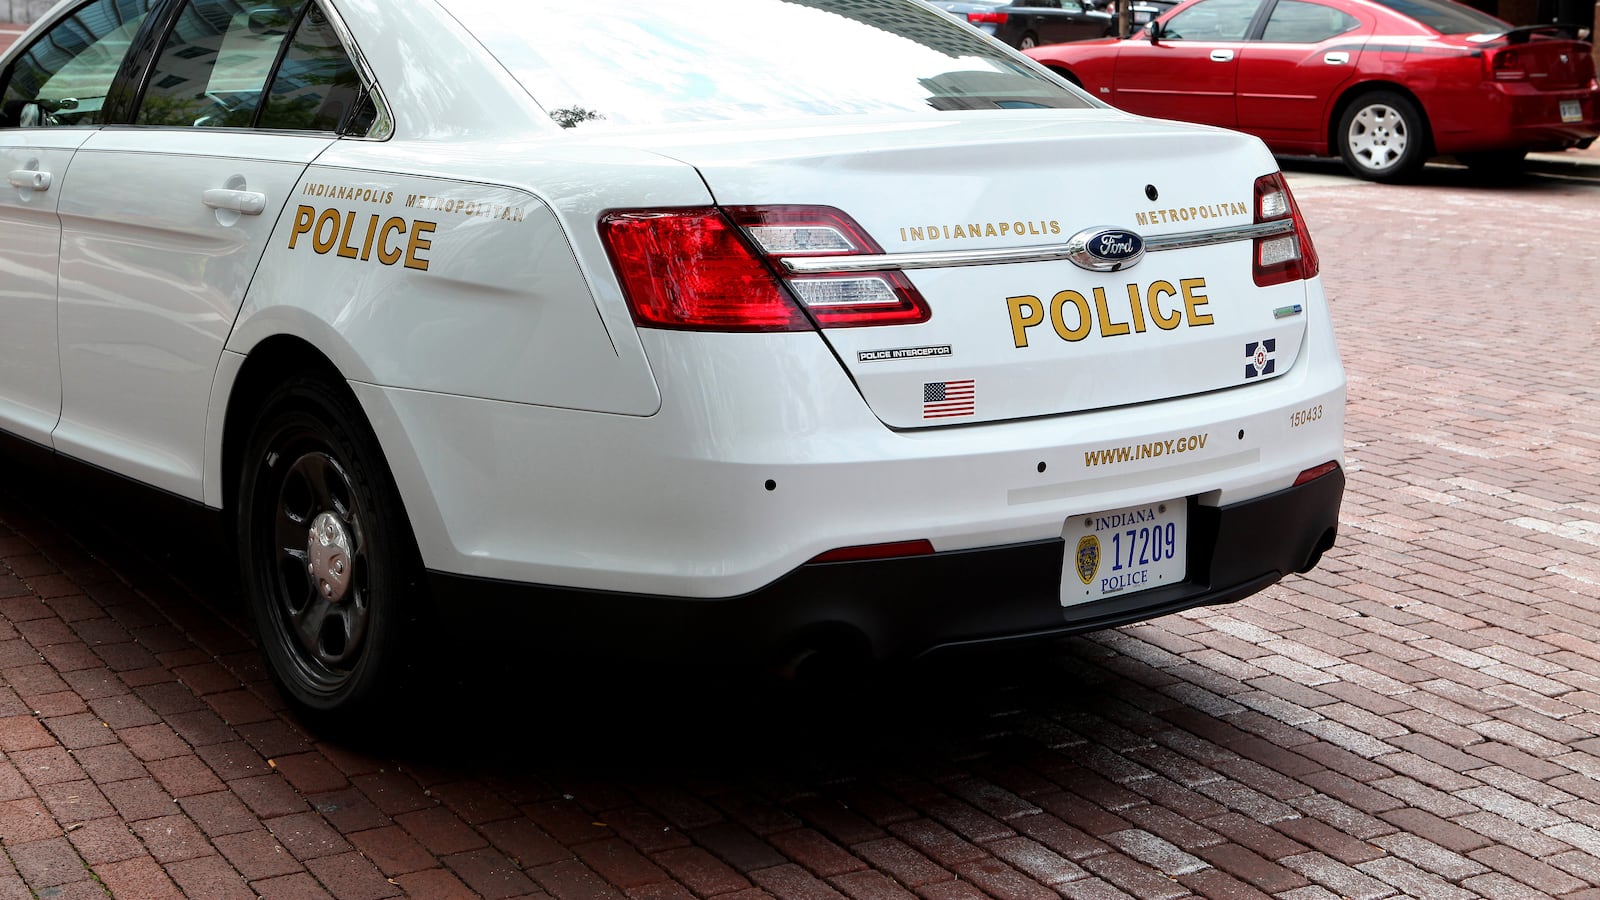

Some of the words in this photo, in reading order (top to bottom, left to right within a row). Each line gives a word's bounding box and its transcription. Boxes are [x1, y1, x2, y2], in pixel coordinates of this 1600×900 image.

[303, 182, 394, 205] INDIANAPOLIS
[405, 194, 525, 223] METROPOLITAN
[288, 204, 437, 272] POLICE
[900, 220, 1062, 242] INDIANAPOLIS
[1135, 202, 1248, 226] METROPOLITAN
[1100, 234, 1134, 256] Ford
[1006, 277, 1215, 349] POLICE
[860, 351, 891, 360] POLICE
[892, 346, 950, 358] INTERCEPTOR
[1289, 404, 1323, 428] 150433
[1084, 433, 1208, 467] WWW.INDY.GOV
[1095, 508, 1156, 532] INDIANA
[1112, 522, 1176, 571] 17209
[1101, 570, 1148, 592] POLICE
